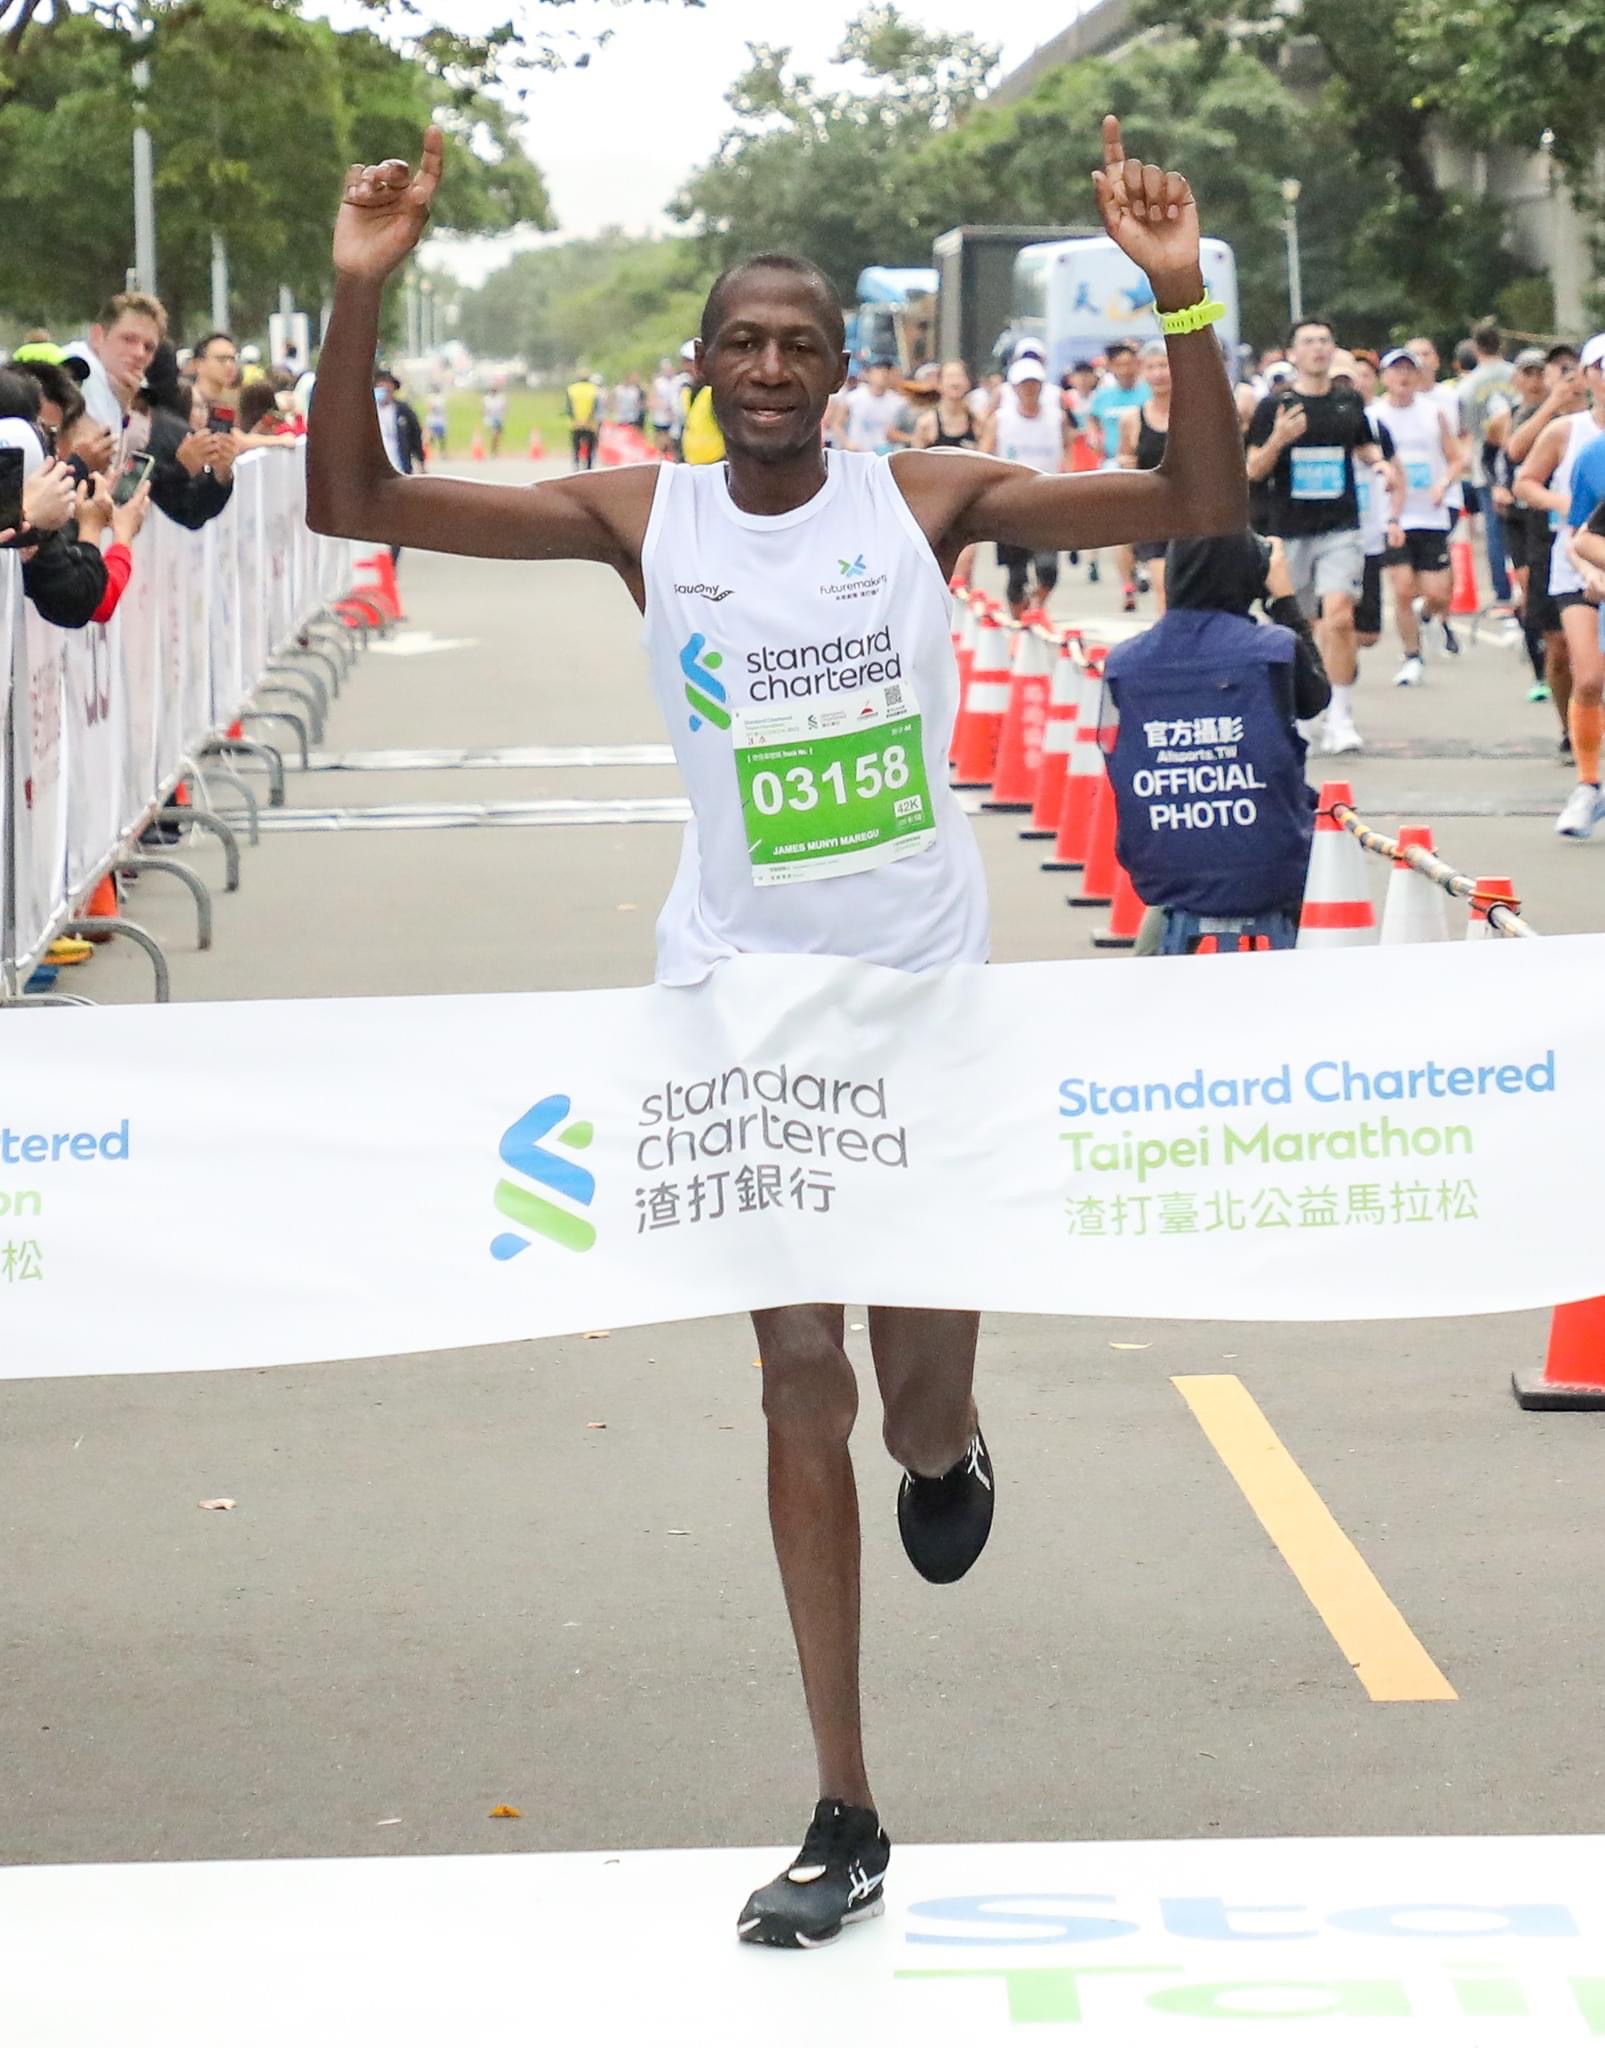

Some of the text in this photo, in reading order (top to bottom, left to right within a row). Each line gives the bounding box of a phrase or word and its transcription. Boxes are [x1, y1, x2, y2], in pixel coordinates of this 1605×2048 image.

[746, 625, 892, 674] standard
[749, 653, 902, 702] chartered
[1142, 716, 1244, 748] 官方攝影
[751, 745, 910, 817] 03158
[896, 798, 919, 814] 42K
[1133, 763, 1267, 797] OFFICIAL
[1149, 798, 1257, 830] PHOTO
[773, 841, 806, 856] JAMES
[808, 838, 839, 851] MUNYI
[840, 829, 880, 846] MAREGU
[638, 1063, 887, 1126] standard
[1058, 1050, 1556, 1117] Standard Chartered
[637, 1105, 909, 1170] chartered
[1059, 1116, 1474, 1183] Taipei Marathon
[634, 1165, 837, 1235] 渣打銀行
[1063, 1178, 1480, 1239] 渣打臺北公益馬拉松
[905, 1892, 1582, 1946] Sta
